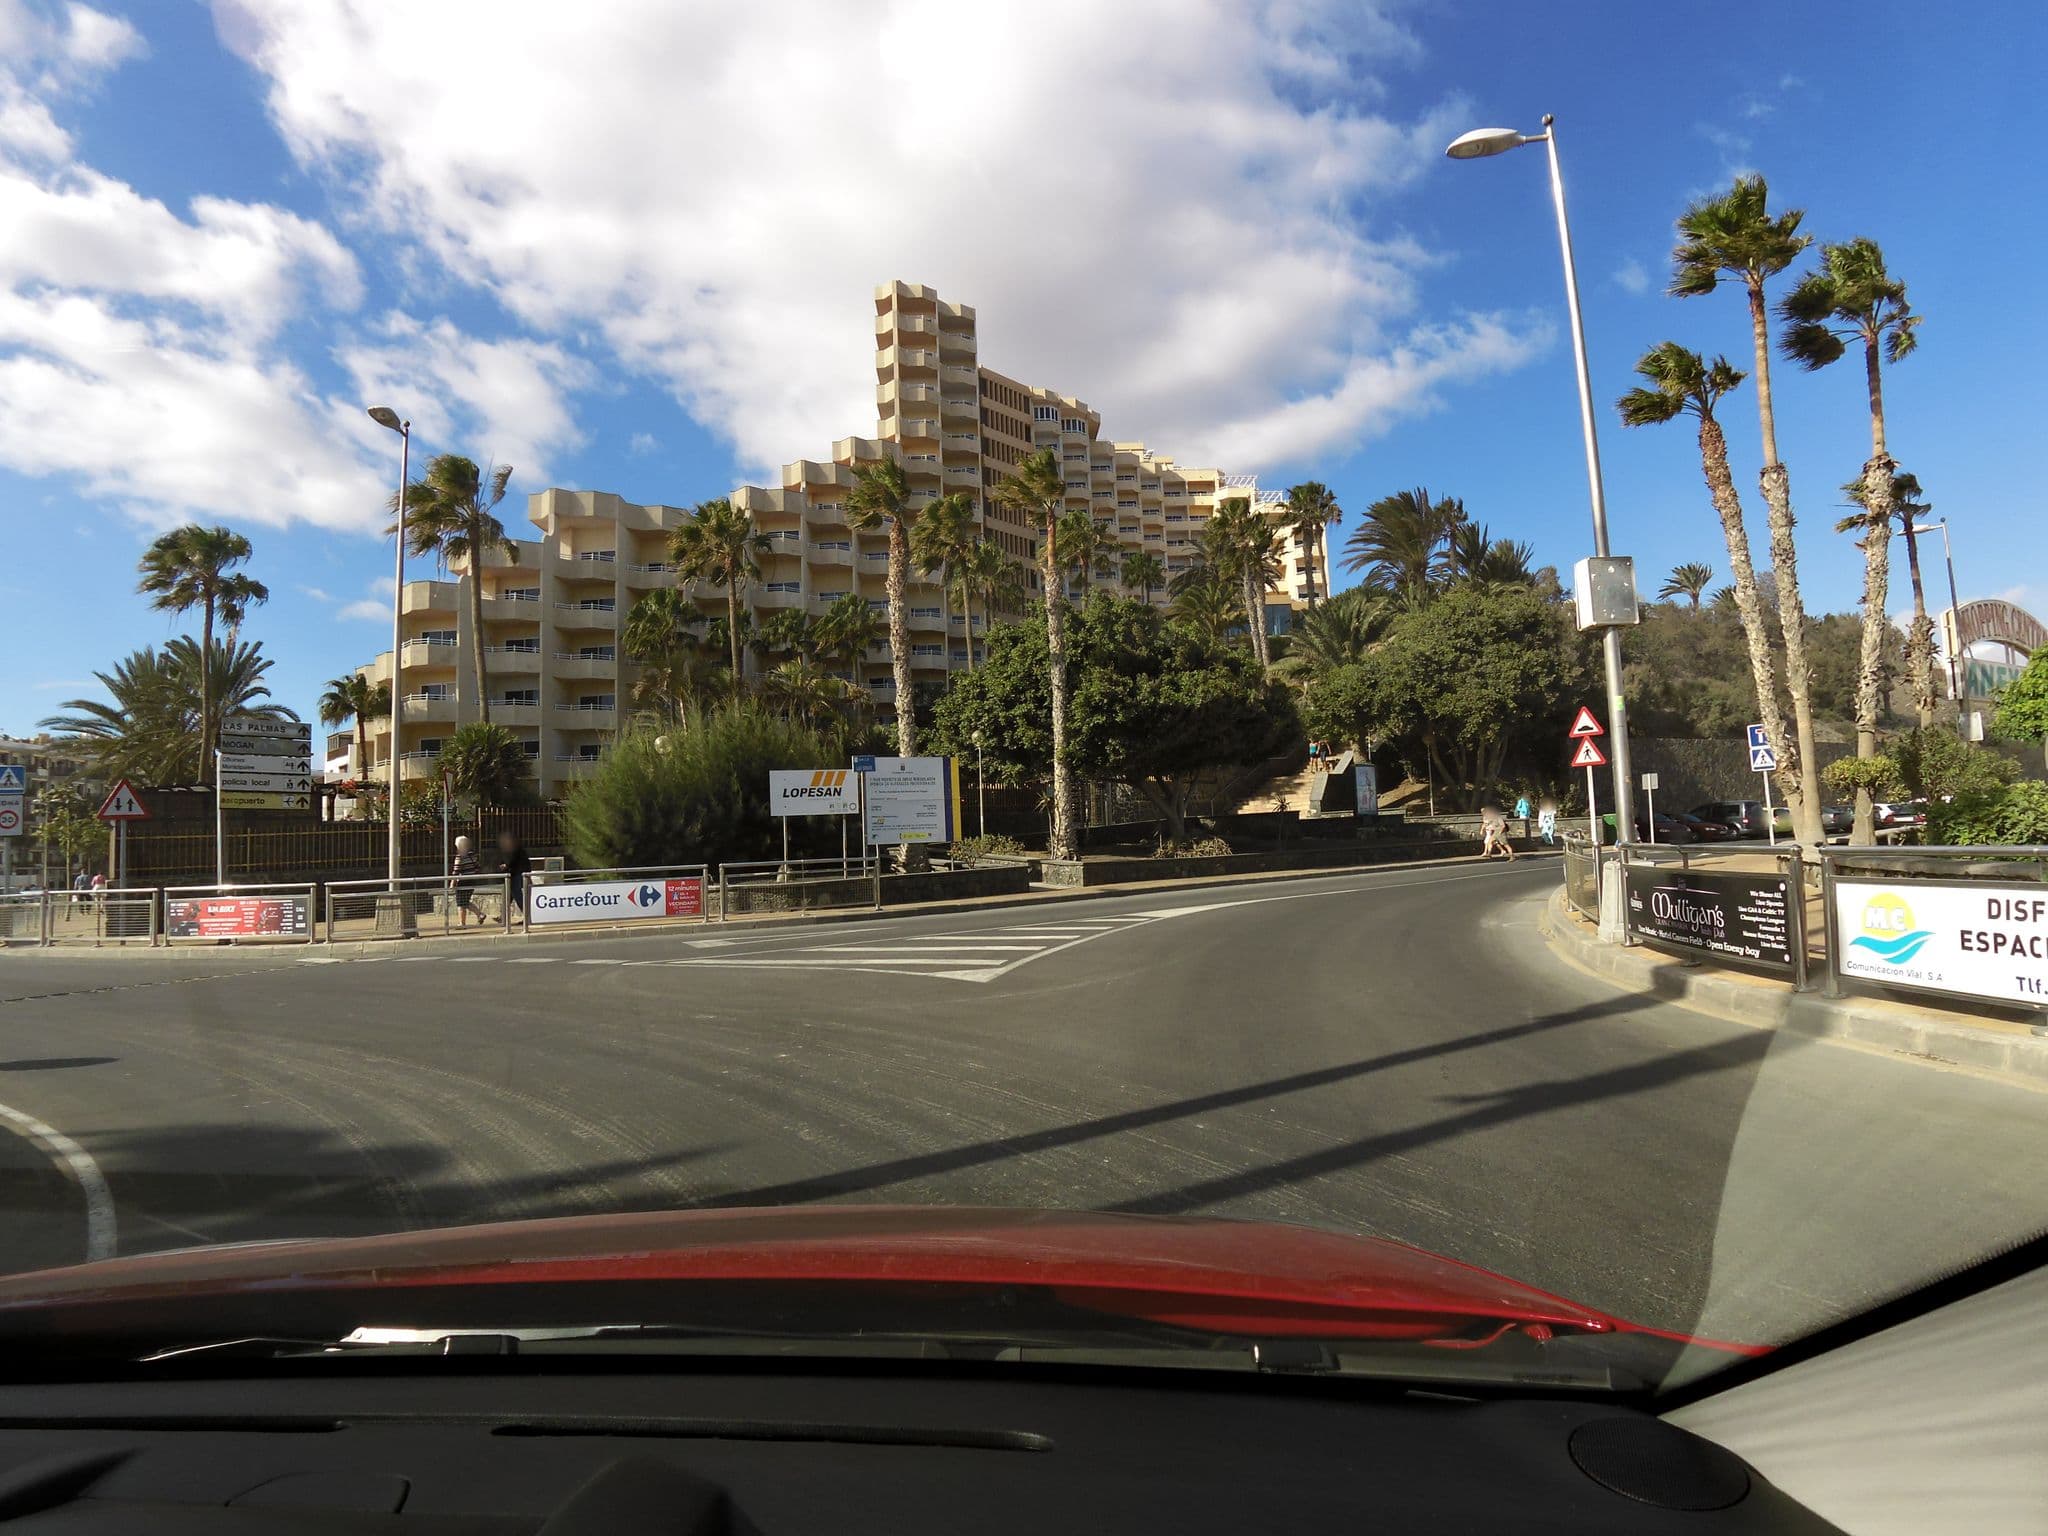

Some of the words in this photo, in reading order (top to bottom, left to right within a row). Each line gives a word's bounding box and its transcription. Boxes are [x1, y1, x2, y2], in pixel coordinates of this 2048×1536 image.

[248, 724, 286, 733] PALMAS
[782, 787, 842, 798] LOPESAN
[222, 797, 265, 805] aeropuerto
[536, 892, 620, 909] Carrefour
[1652, 892, 1724, 932] Mulligan's
[1706, 939, 1723, 950] Open
[1960, 930, 2048, 959] ESPAC
